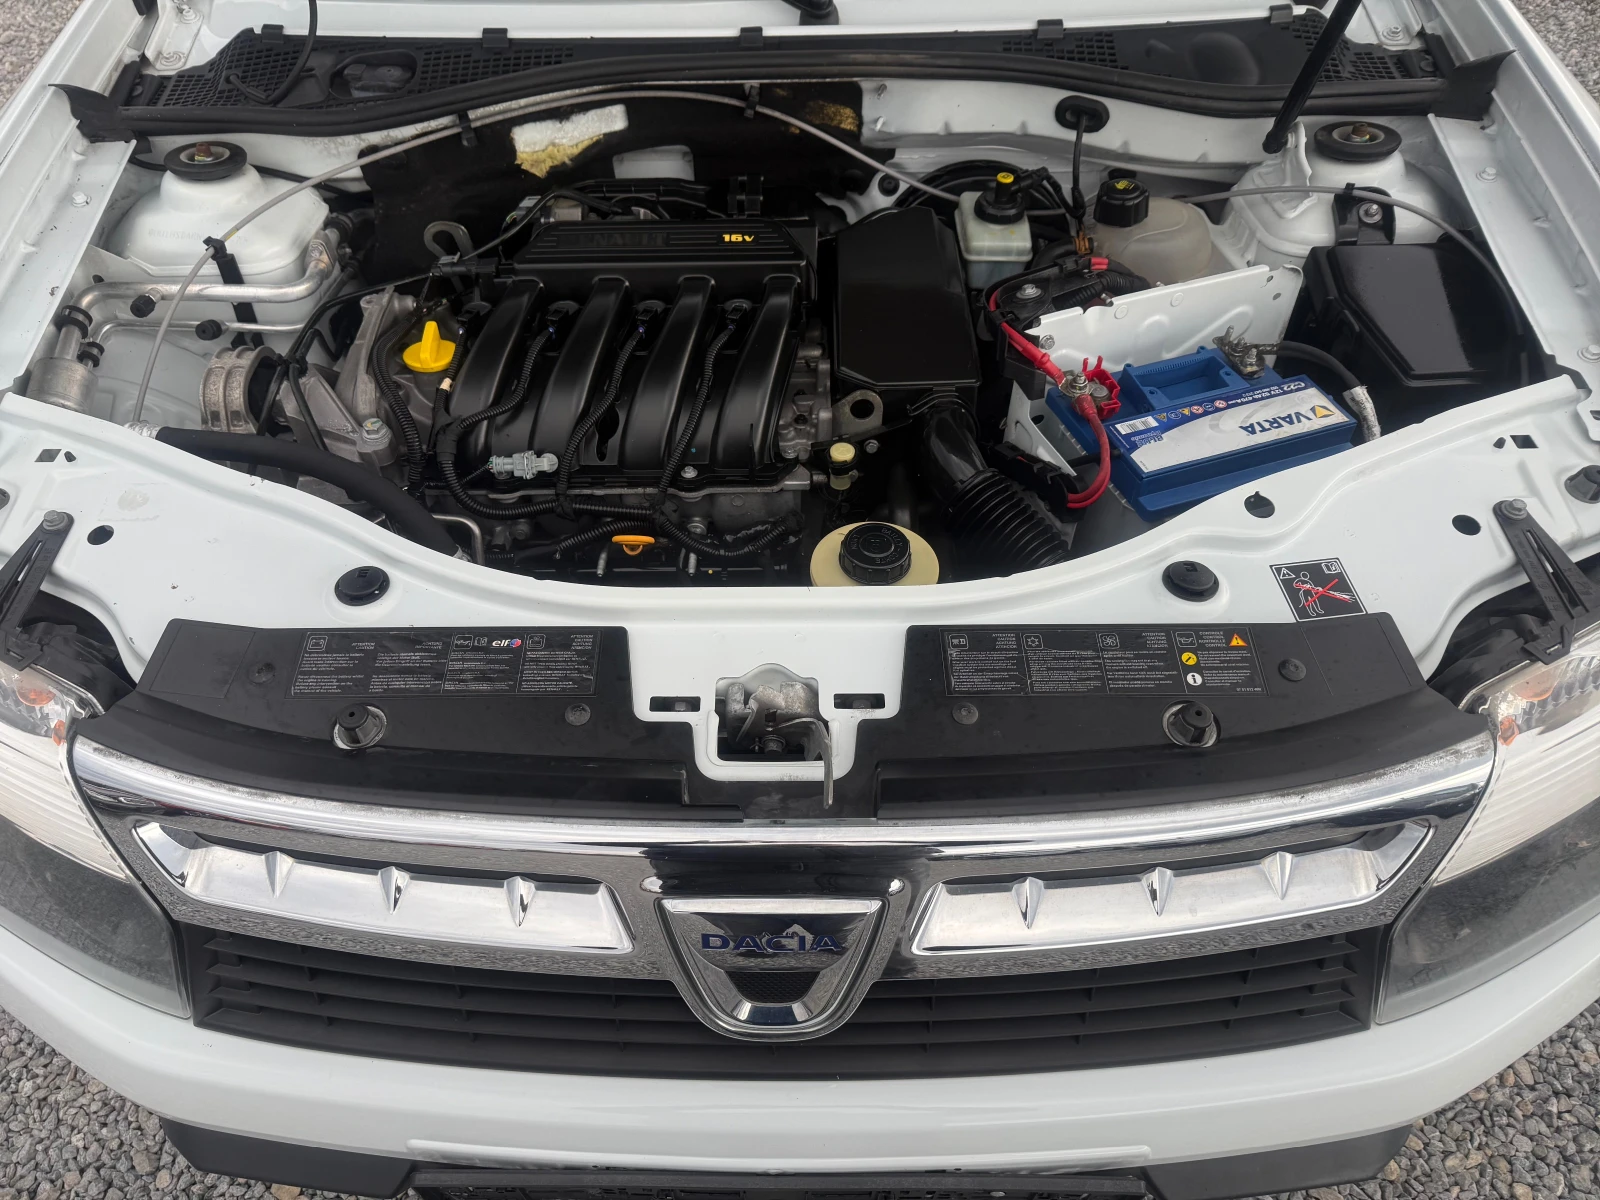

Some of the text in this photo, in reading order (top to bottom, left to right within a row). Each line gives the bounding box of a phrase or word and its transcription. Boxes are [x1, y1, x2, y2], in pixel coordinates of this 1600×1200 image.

[1238, 411, 1313, 435] VARTA
[492, 639, 511, 647] elf
[701, 933, 842, 953] DACIA
